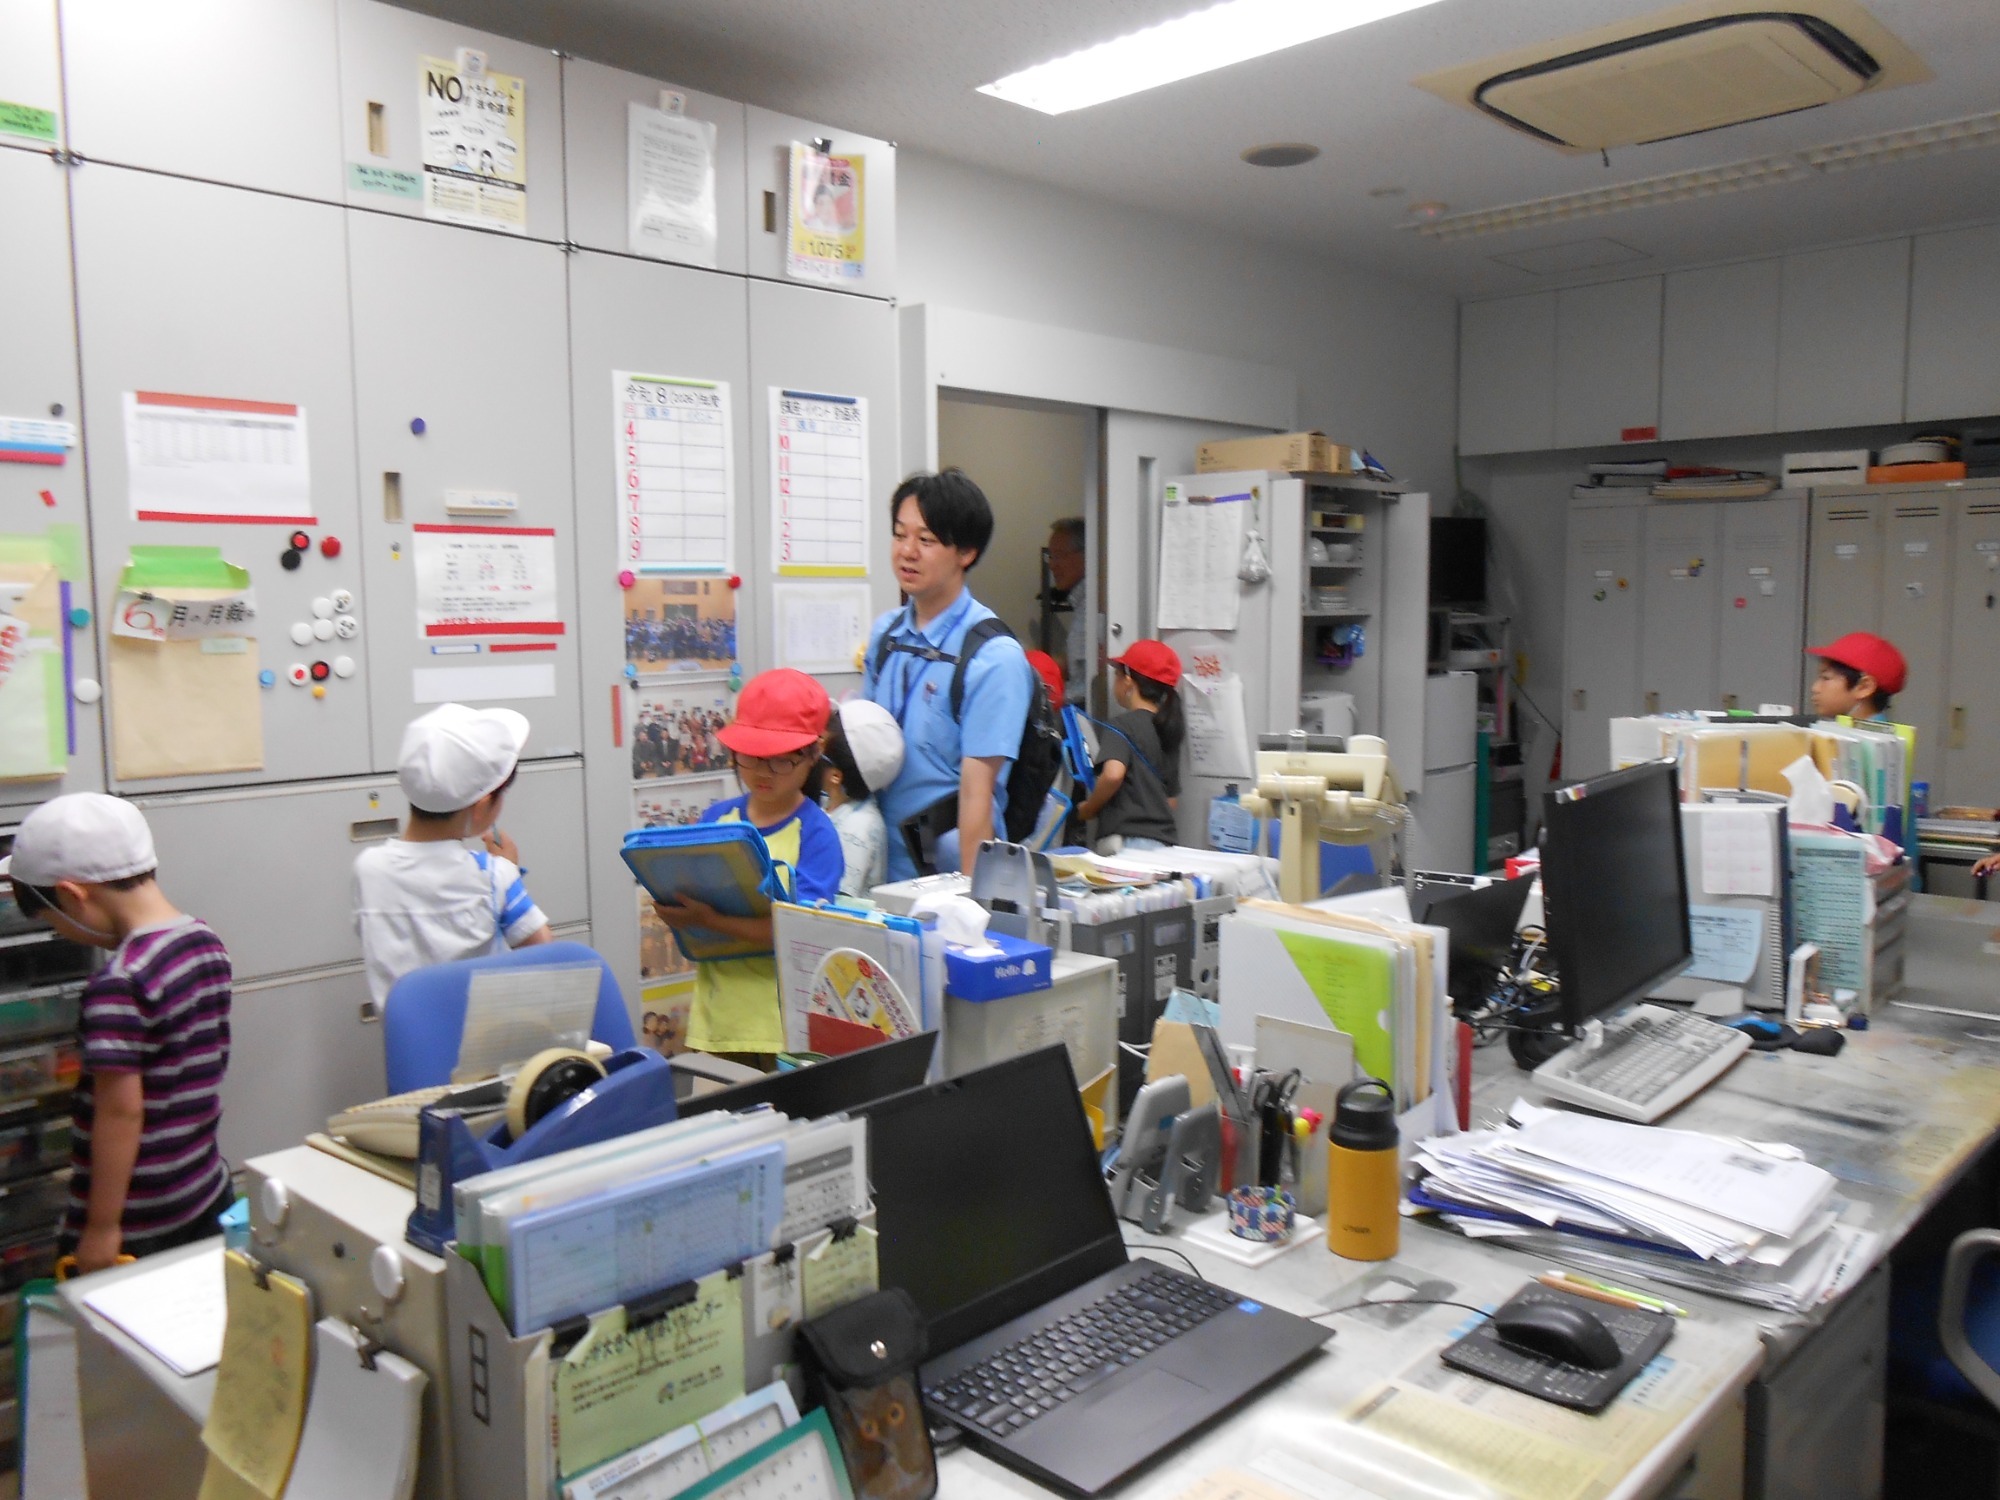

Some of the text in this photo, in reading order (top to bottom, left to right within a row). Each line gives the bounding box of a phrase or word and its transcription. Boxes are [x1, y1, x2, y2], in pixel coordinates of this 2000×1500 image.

[427, 71, 463, 103] NO
[625, 420, 636, 442] 4
[779, 434, 791, 450] 10
[627, 446, 638, 466] 5
[779, 455, 790, 473] 11
[628, 470, 639, 489] 6
[779, 478, 791, 495] 12
[629, 494, 640, 514] 7
[781, 500, 787, 517] 1
[630, 516, 641, 536] 8
[782, 521, 791, 540] 2
[631, 540, 641, 560] 9
[782, 542, 792, 562] 3
[123, 599, 157, 630] 6
